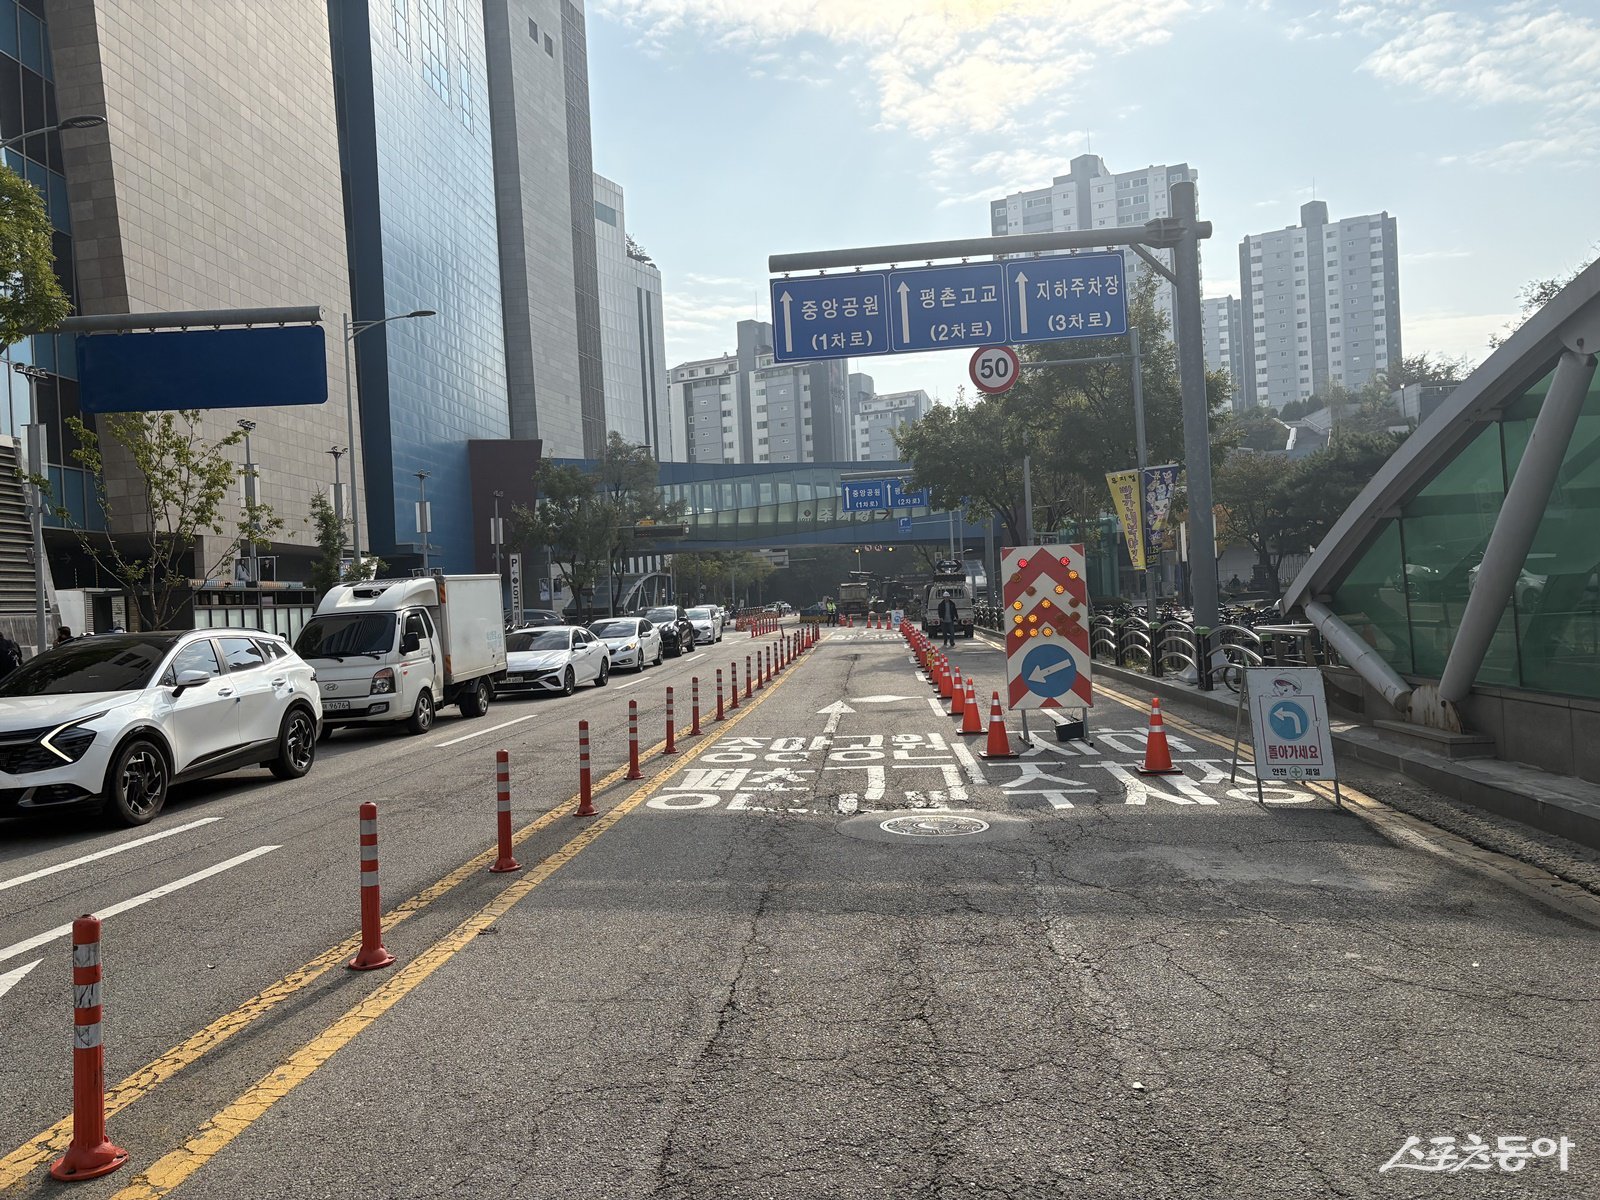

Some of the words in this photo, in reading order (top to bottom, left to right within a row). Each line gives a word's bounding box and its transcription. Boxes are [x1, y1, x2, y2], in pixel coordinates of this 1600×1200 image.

[919, 284, 998, 309] 평촌고교
[1036, 274, 1120, 301] 지하주차장
[800, 294, 880, 321] 중앙공원
[929, 320, 993, 342] (2차로)
[1047, 310, 1112, 332] (3차로)
[811, 329, 874, 351] (1차로)
[979, 358, 1009, 379] 50
[852, 488, 881, 498] 중앙공원
[855, 500, 879, 509] (1차로)
[511, 558, 518, 568] P
[700, 732, 953, 763] 중앙공원
[1268, 745, 1319, 760] 돌아가세요
[1272, 768, 1287, 776] 안전
[1305, 768, 1320, 776] 제일
